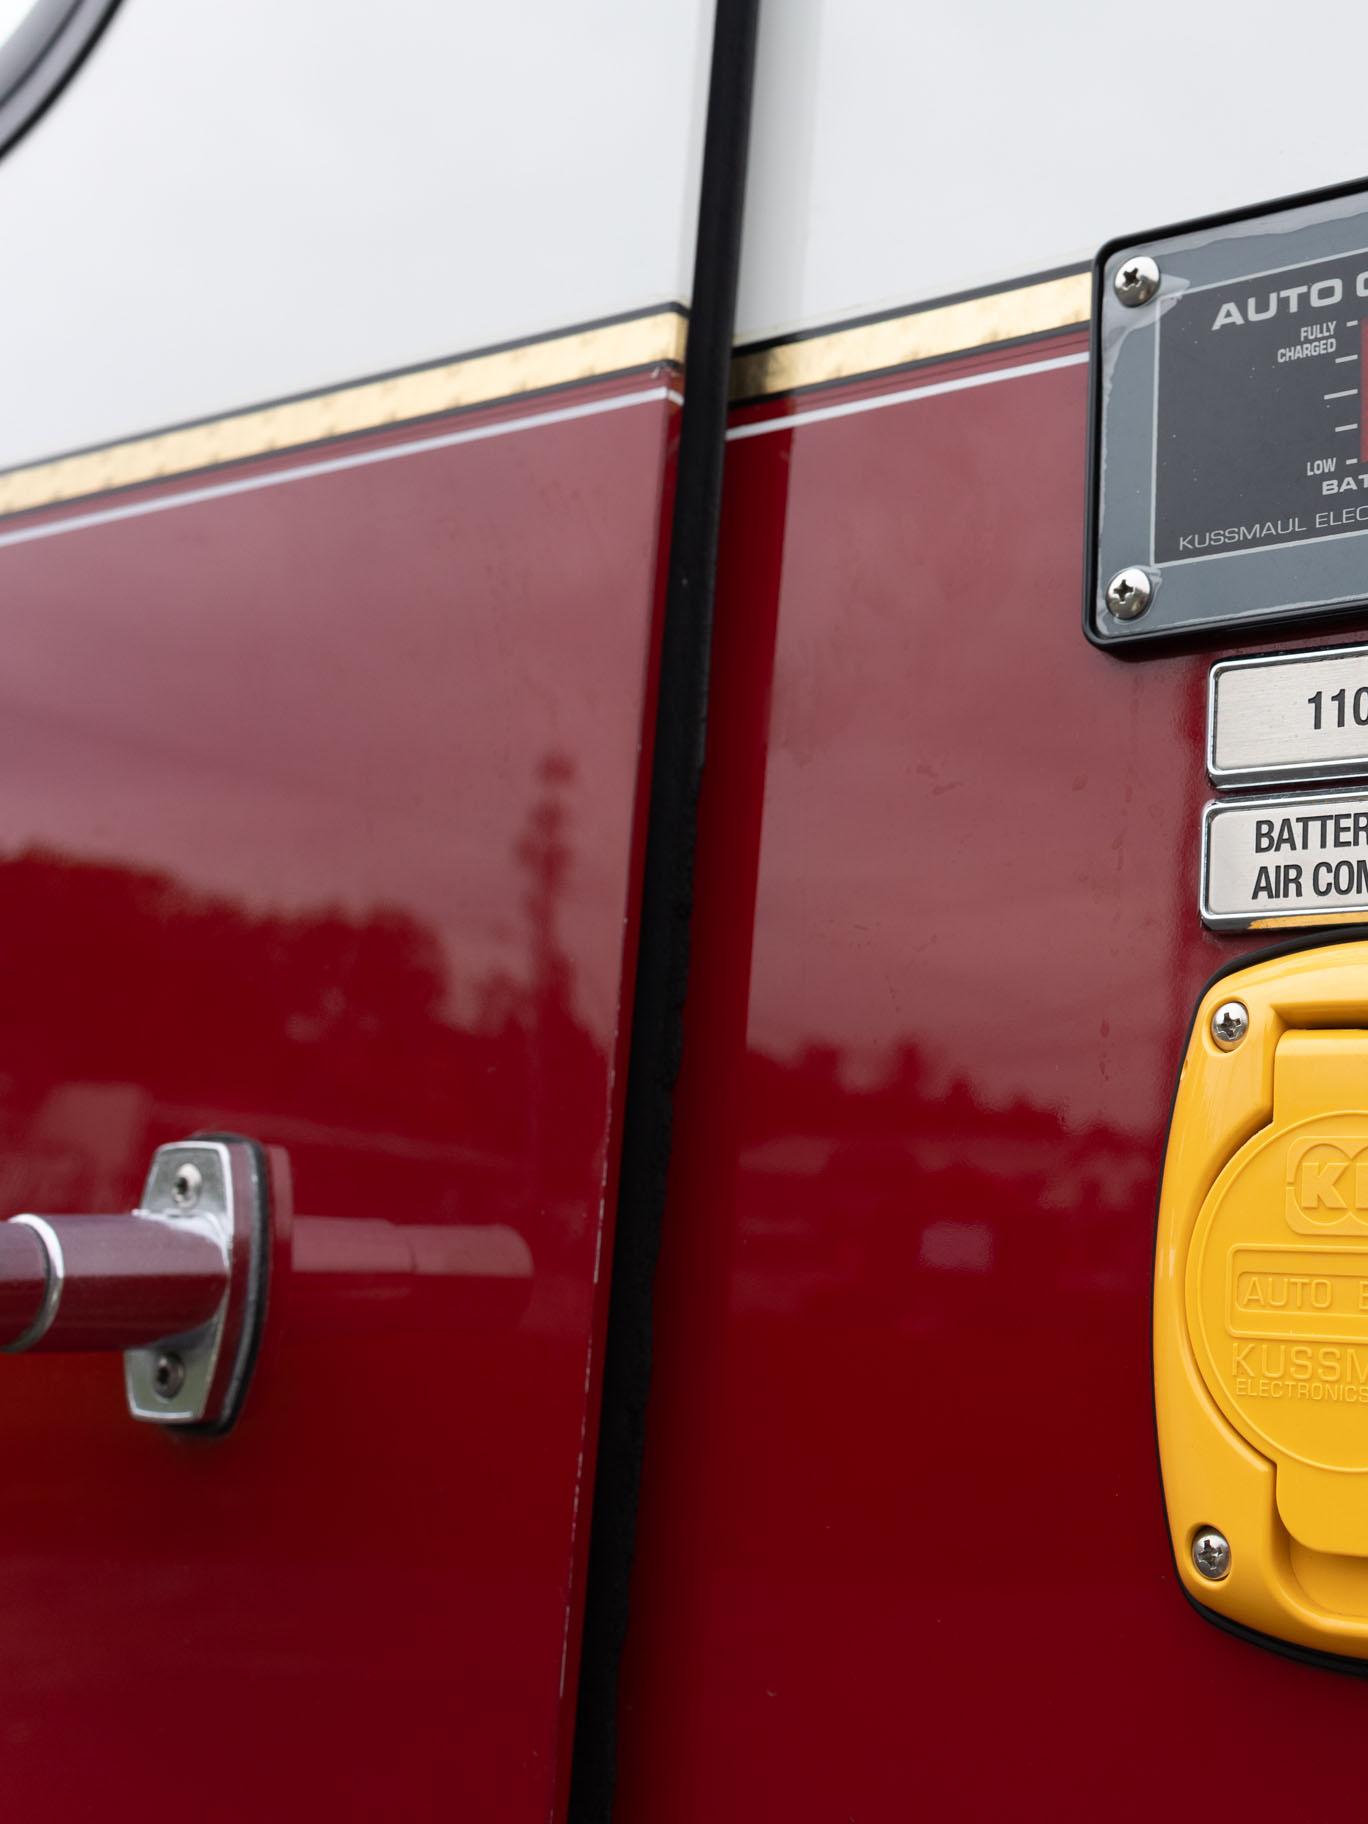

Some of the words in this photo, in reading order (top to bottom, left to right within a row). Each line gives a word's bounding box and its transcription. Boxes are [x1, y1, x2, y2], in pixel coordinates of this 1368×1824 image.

[1211, 278, 1343, 331] AUTO
[1301, 321, 1336, 341] FULLY
[1278, 339, 1336, 363] CHARGED
[1307, 458, 1337, 477] LOW
[1178, 517, 1307, 552] KUSSMAUL
[1250, 864, 1303, 901] AIR
[1242, 1276, 1333, 1309] AUTO
